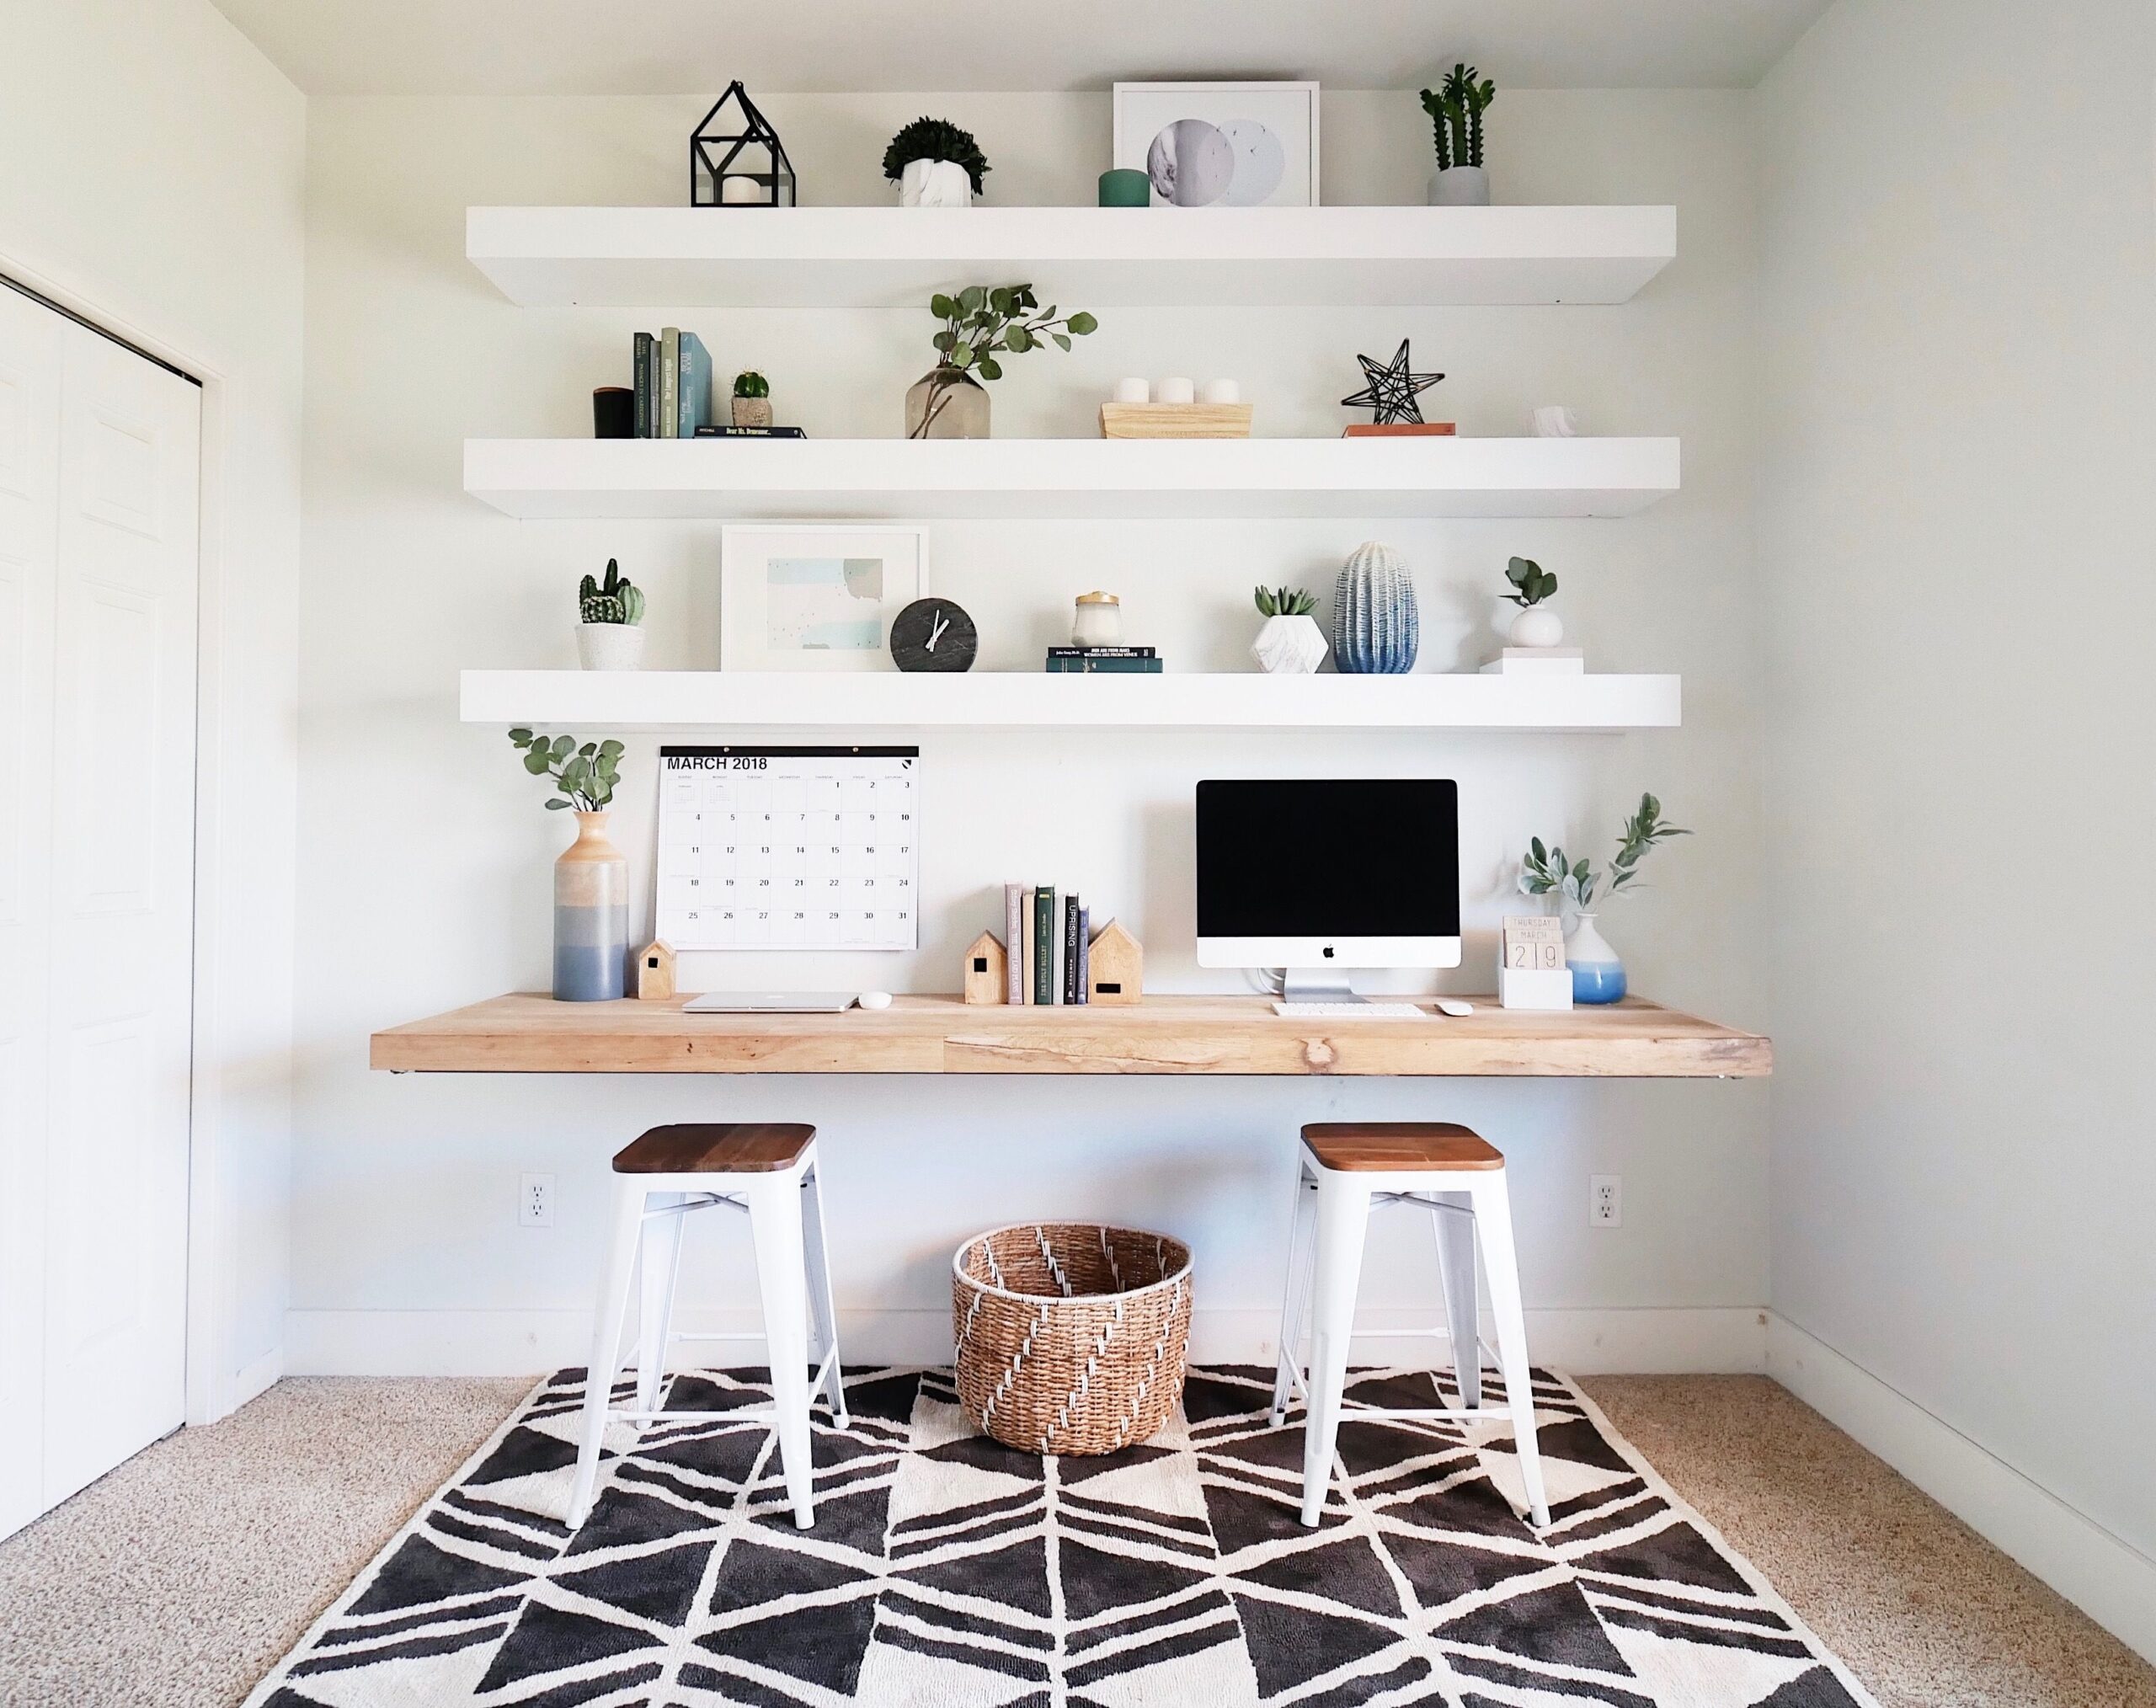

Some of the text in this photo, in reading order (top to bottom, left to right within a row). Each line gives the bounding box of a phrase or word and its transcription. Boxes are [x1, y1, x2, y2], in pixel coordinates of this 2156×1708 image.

[668, 757, 768, 770] MARCH 2018
[727, 846, 735, 854] 12
[794, 878, 803, 887] 21
[899, 878, 909, 887] 24
[723, 911, 734, 920] 26
[1068, 905, 1076, 947] UPRISING
[1514, 918, 1551, 927] THURSDAY
